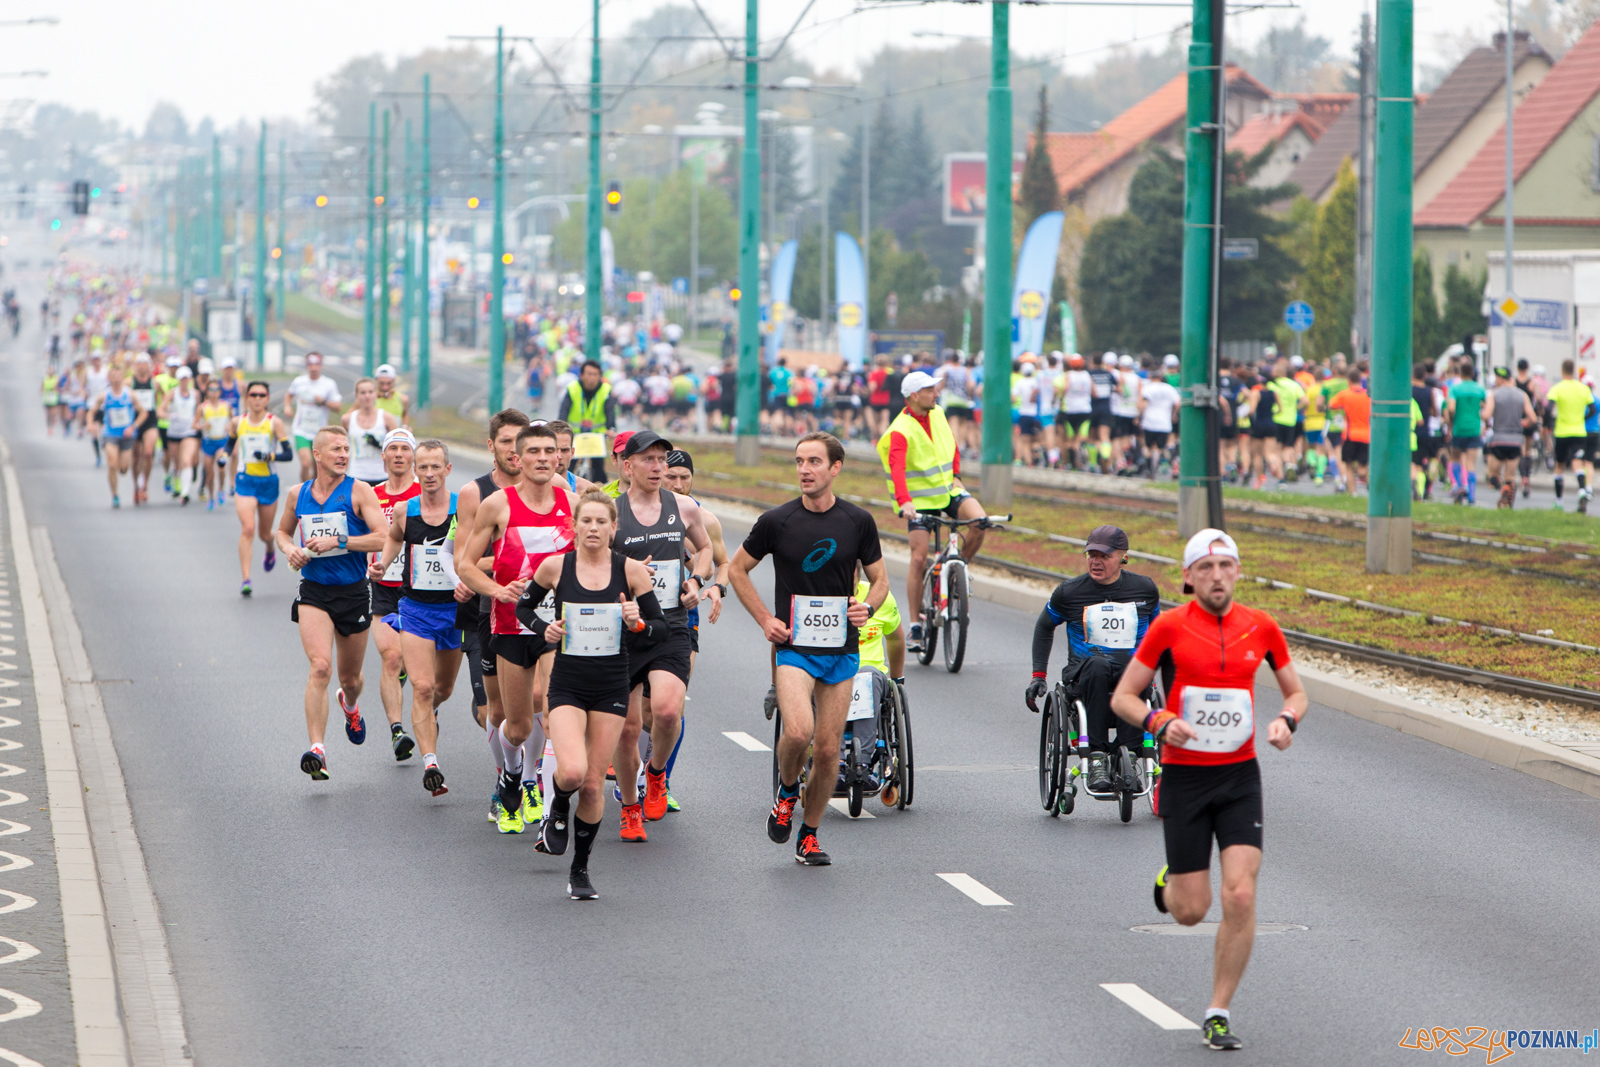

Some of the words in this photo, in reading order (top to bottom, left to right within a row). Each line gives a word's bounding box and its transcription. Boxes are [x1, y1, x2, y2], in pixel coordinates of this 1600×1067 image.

[803, 614, 839, 627] 6503
[1102, 617, 1125, 630] 201
[1195, 710, 1242, 727] 2609
